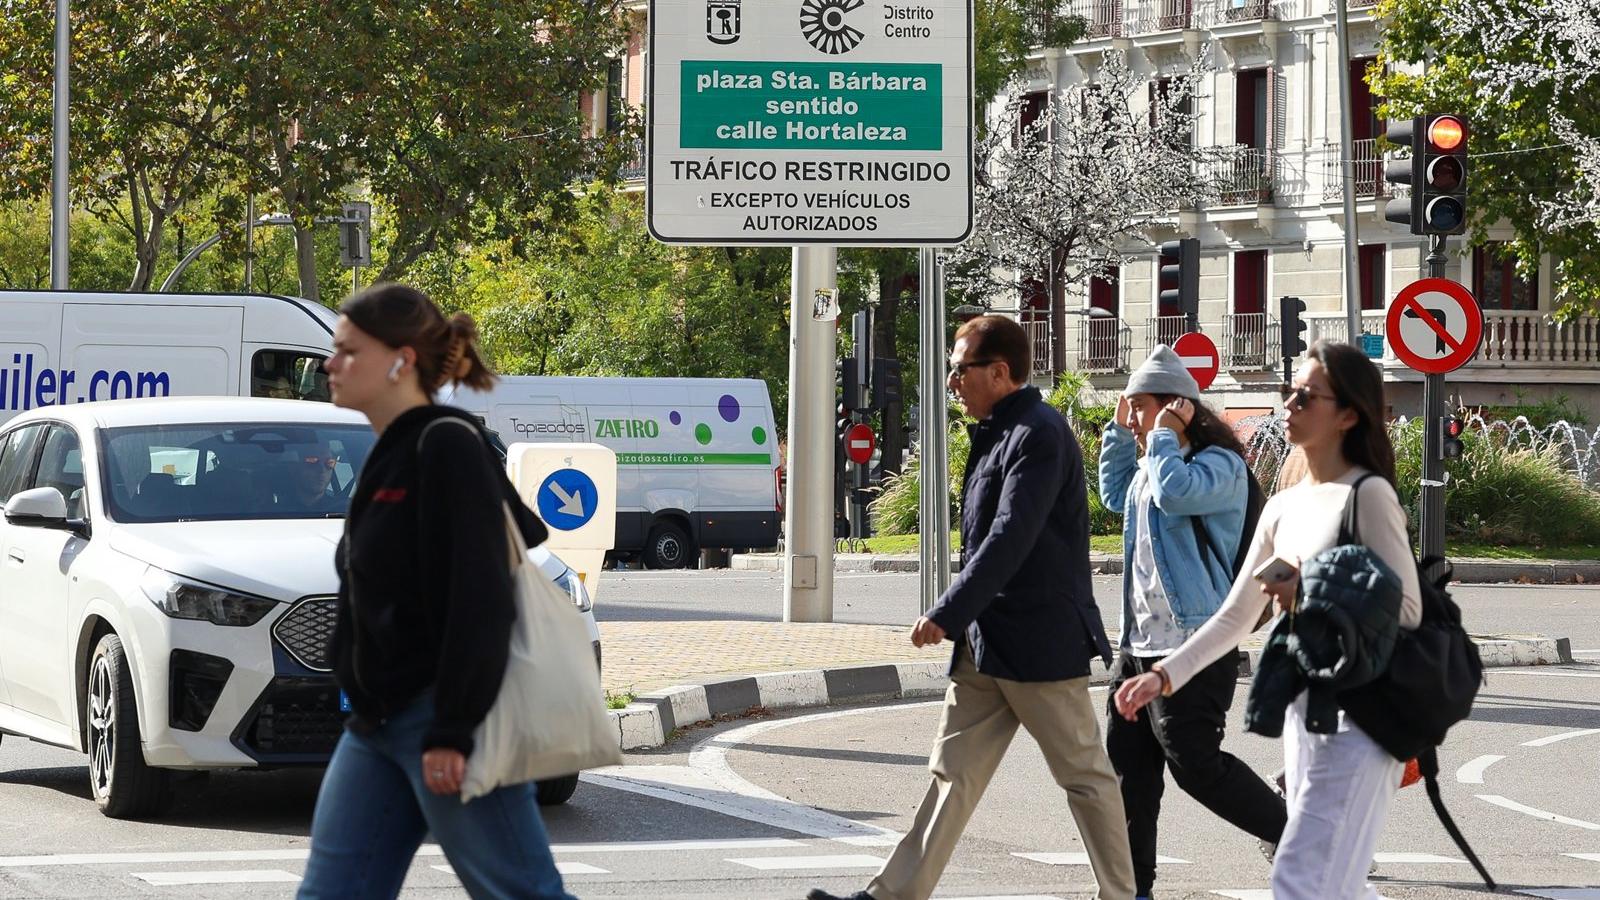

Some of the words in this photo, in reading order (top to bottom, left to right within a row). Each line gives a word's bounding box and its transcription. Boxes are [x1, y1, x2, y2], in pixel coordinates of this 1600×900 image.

[883, 5, 934, 20] Distrito
[884, 24, 931, 38] Centro
[697, 70, 763, 93] plaza
[771, 71, 820, 91] Sta.
[829, 71, 927, 92] Bárbara
[766, 97, 859, 115] sentido
[716, 121, 778, 140] calle
[786, 122, 907, 141] Hortaleza
[670, 156, 777, 181] TRÁFICO
[785, 160, 951, 182] RESTRINGIDO
[711, 192, 798, 208] EXCEPTO
[804, 190, 911, 209] VEHÍCULOS
[742, 215, 878, 231] AUTORIZADOS
[509, 418, 586, 438] Tapizados
[594, 419, 660, 439] ZAFIRO
